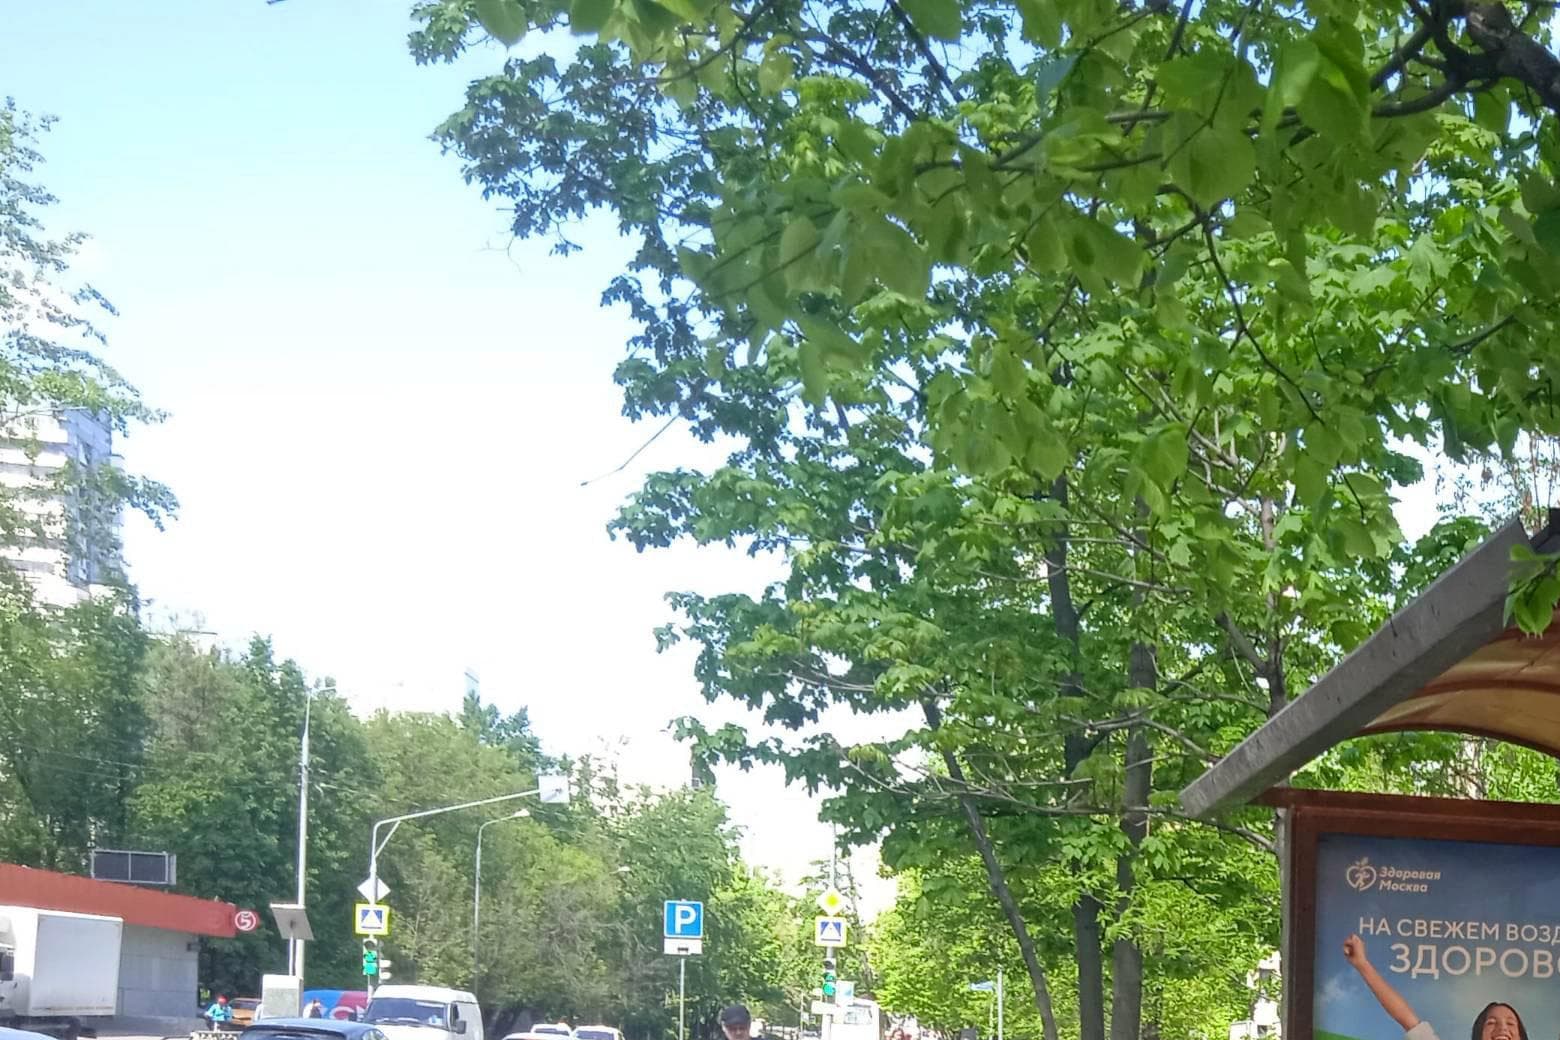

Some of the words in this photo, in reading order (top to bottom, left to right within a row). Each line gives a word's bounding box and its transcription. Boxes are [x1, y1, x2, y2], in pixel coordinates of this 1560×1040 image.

[1379, 866, 1441, 880] Здоровая
[1379, 880, 1428, 892] Москва
[674, 905, 697, 934] P
[1359, 917, 1391, 936] НА
[1397, 918, 1500, 941] СВЕЖЕМ
